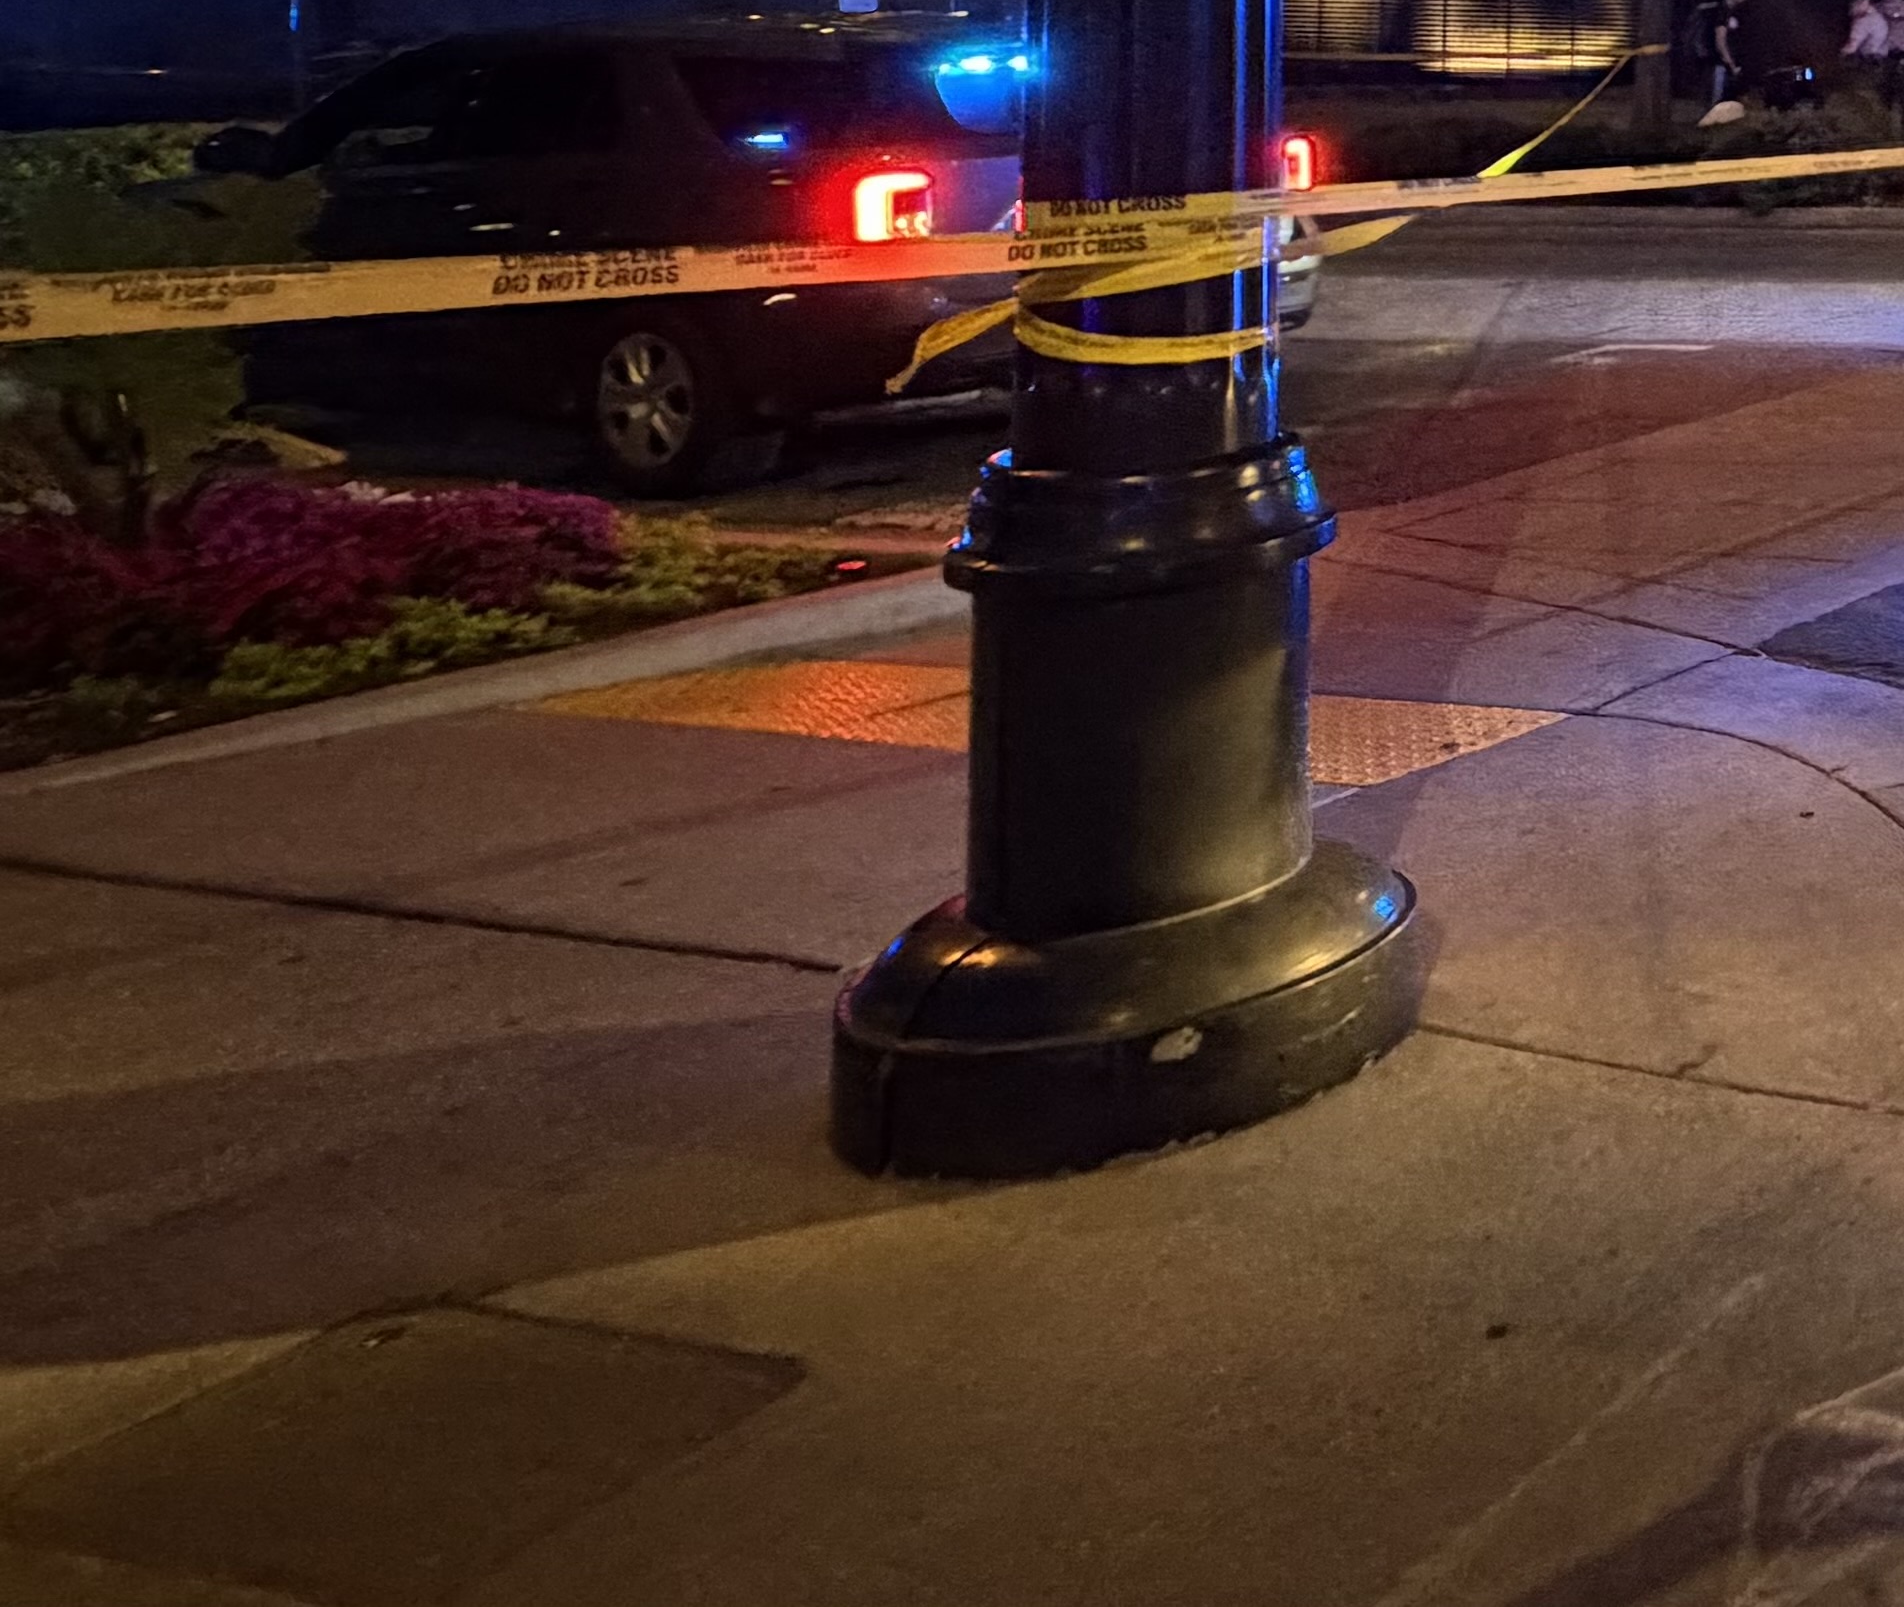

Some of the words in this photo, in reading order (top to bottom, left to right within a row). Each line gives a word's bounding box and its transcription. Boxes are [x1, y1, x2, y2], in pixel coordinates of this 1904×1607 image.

[1008, 244, 1034, 261] DO
[1040, 240, 1081, 259] NOT
[1083, 235, 1148, 256] CROSS
[492, 273, 530, 295] DO
[537, 269, 590, 293] NOT
[595, 265, 680, 288] CROSS
